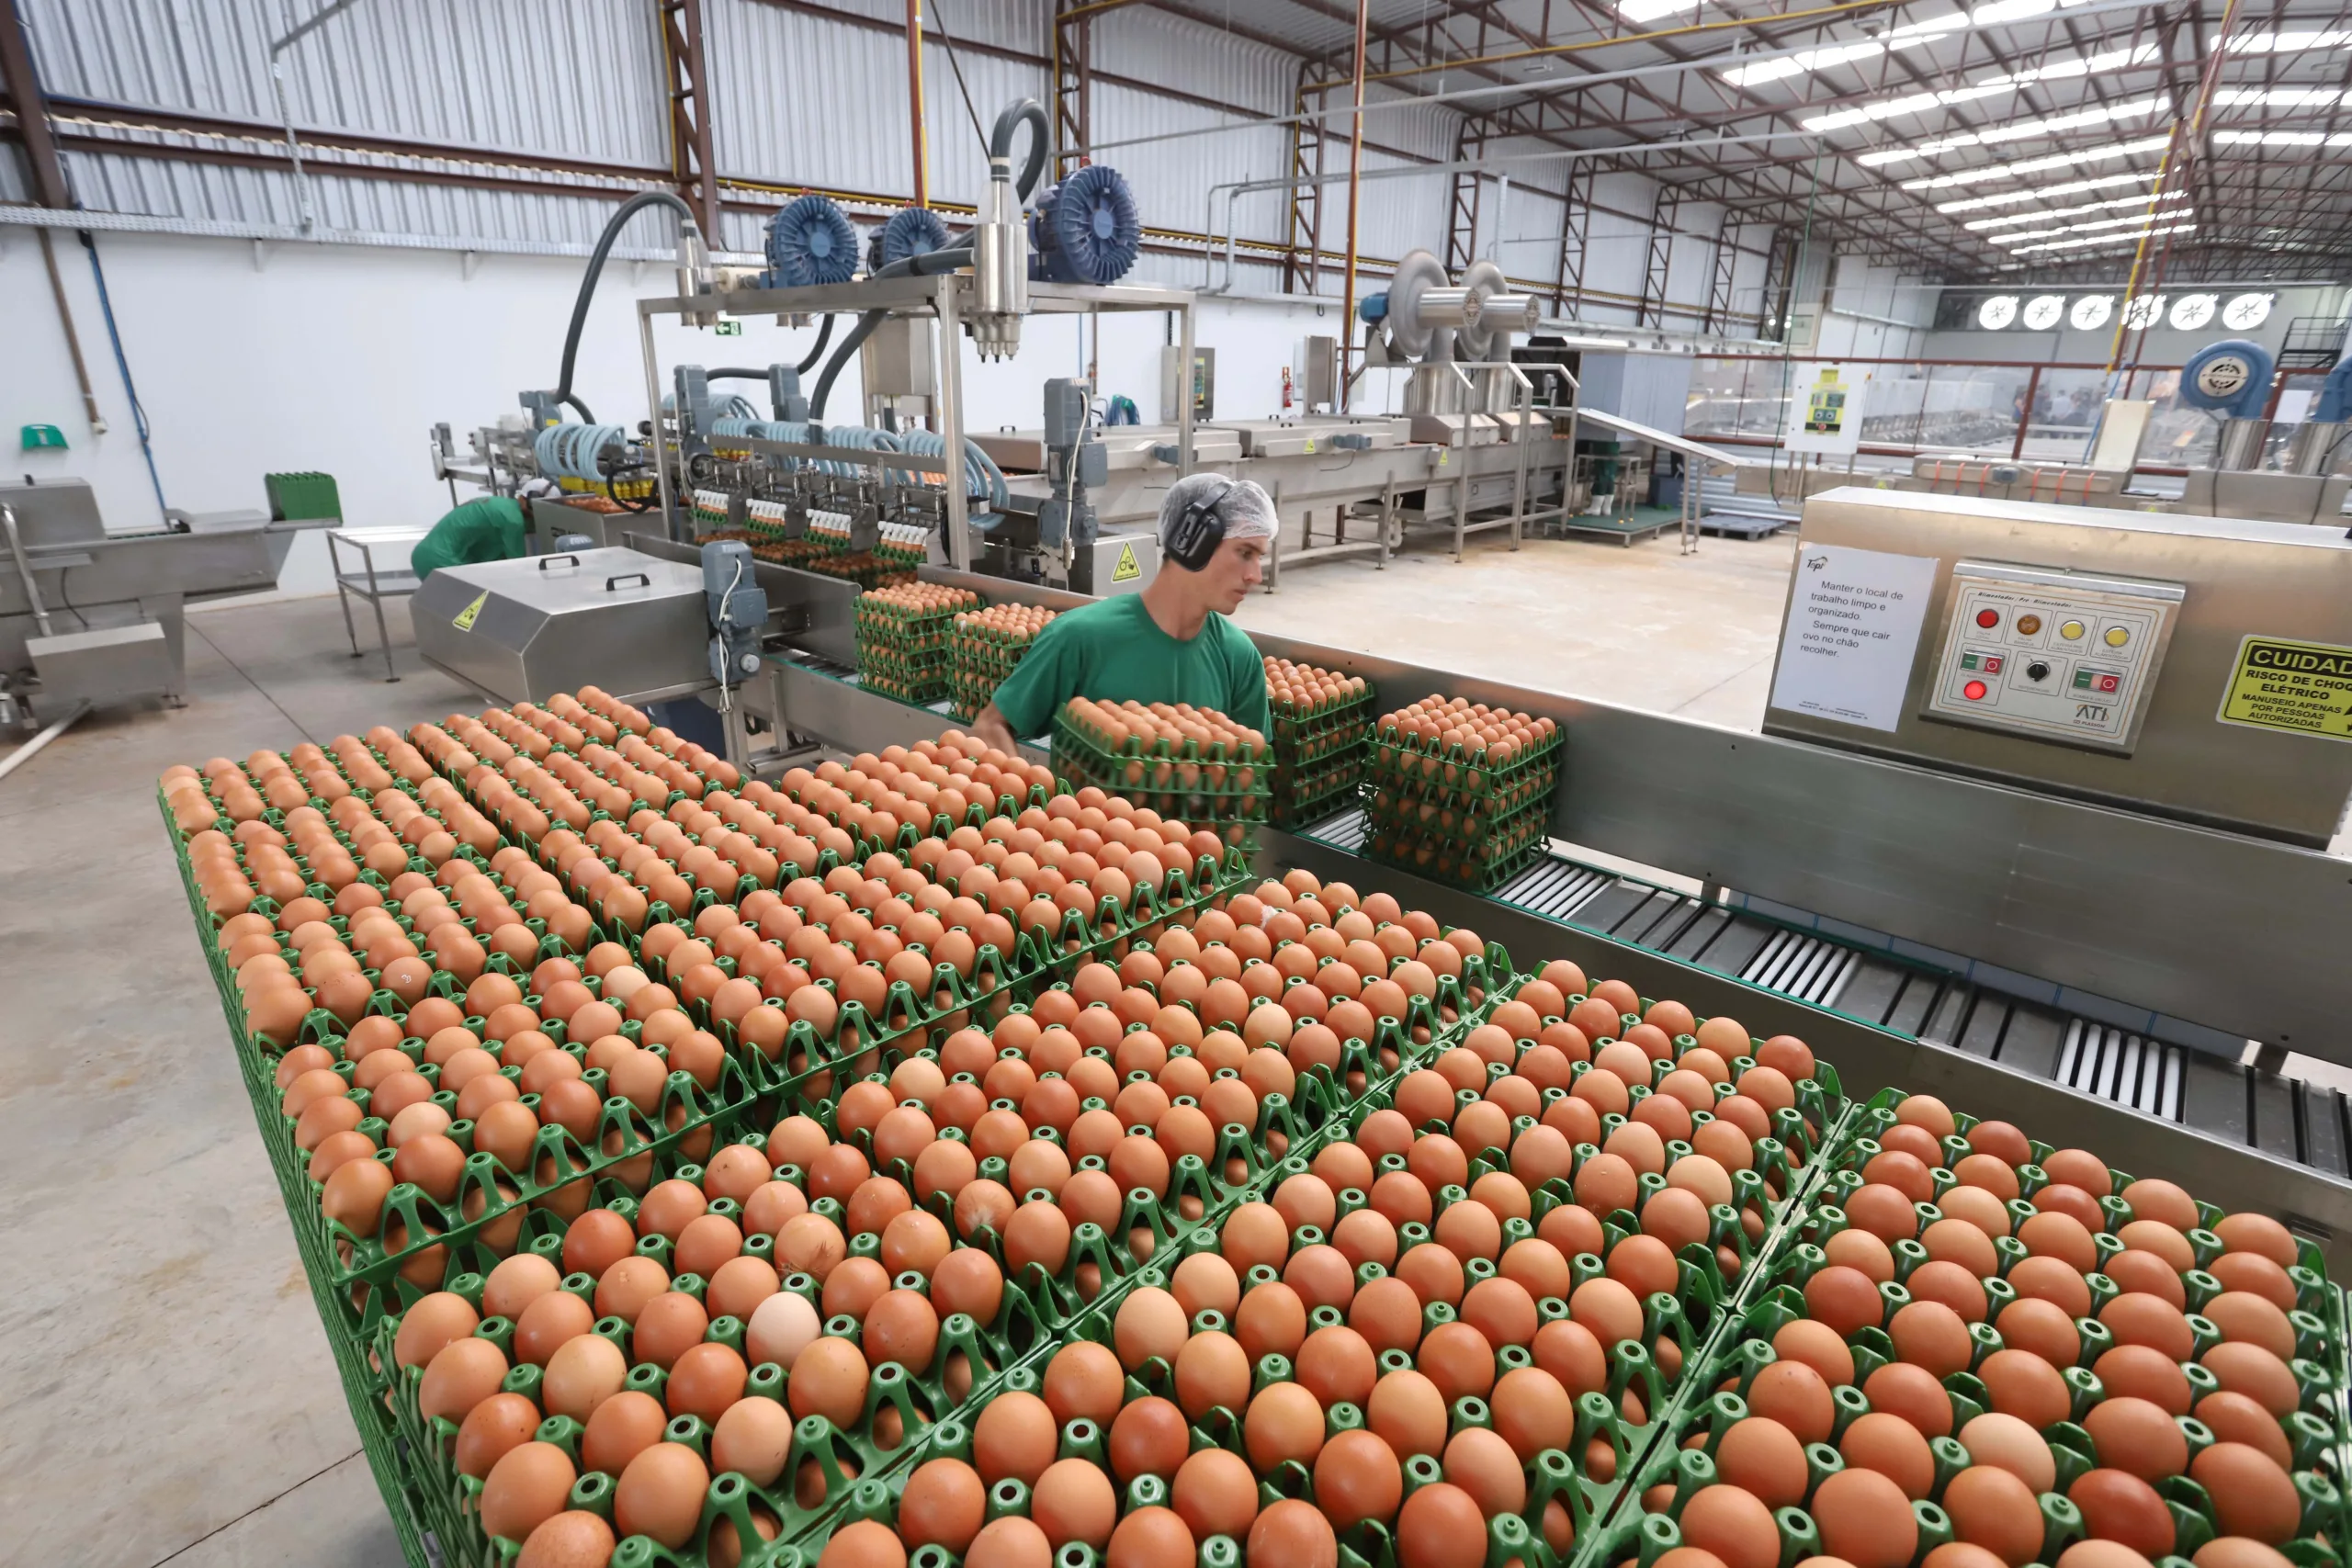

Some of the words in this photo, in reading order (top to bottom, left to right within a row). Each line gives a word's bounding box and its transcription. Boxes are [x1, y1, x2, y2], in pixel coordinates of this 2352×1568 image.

[1821, 581, 1854, 593] Manter
[1856, 586, 1863, 594] o
[1865, 587, 1888, 599] local
[1890, 591, 1904, 601] de
[1811, 592, 1849, 606] trabalho
[1850, 598, 1877, 612] limpo
[1879, 604, 1886, 612] e
[1978, 592, 2015, 602] Alimentador
[2033, 598, 2072, 609] Alimentador
[1808, 605, 1862, 622] organizado.
[1813, 620, 1849, 635] Sempre
[1851, 627, 1870, 637] que
[1871, 629, 1891, 641] cair
[1803, 632, 1820, 642] ovo
[1822, 636, 1834, 644] no
[1836, 637, 1860, 649] chão
[1800, 643, 1840, 659] recolher.
[2245, 670, 2288, 682] RISCO
[2291, 675, 2311, 685] DE
[2261, 682, 2330, 700] ELÉTRICO
[2242, 694, 2296, 707] MANUSEIO
[2297, 702, 2342, 714] APENAS
[2251, 704, 2273, 712] POR
[2276, 706, 2325, 720] PESSOAS
[2248, 711, 2323, 728] AUTORIZADAS
